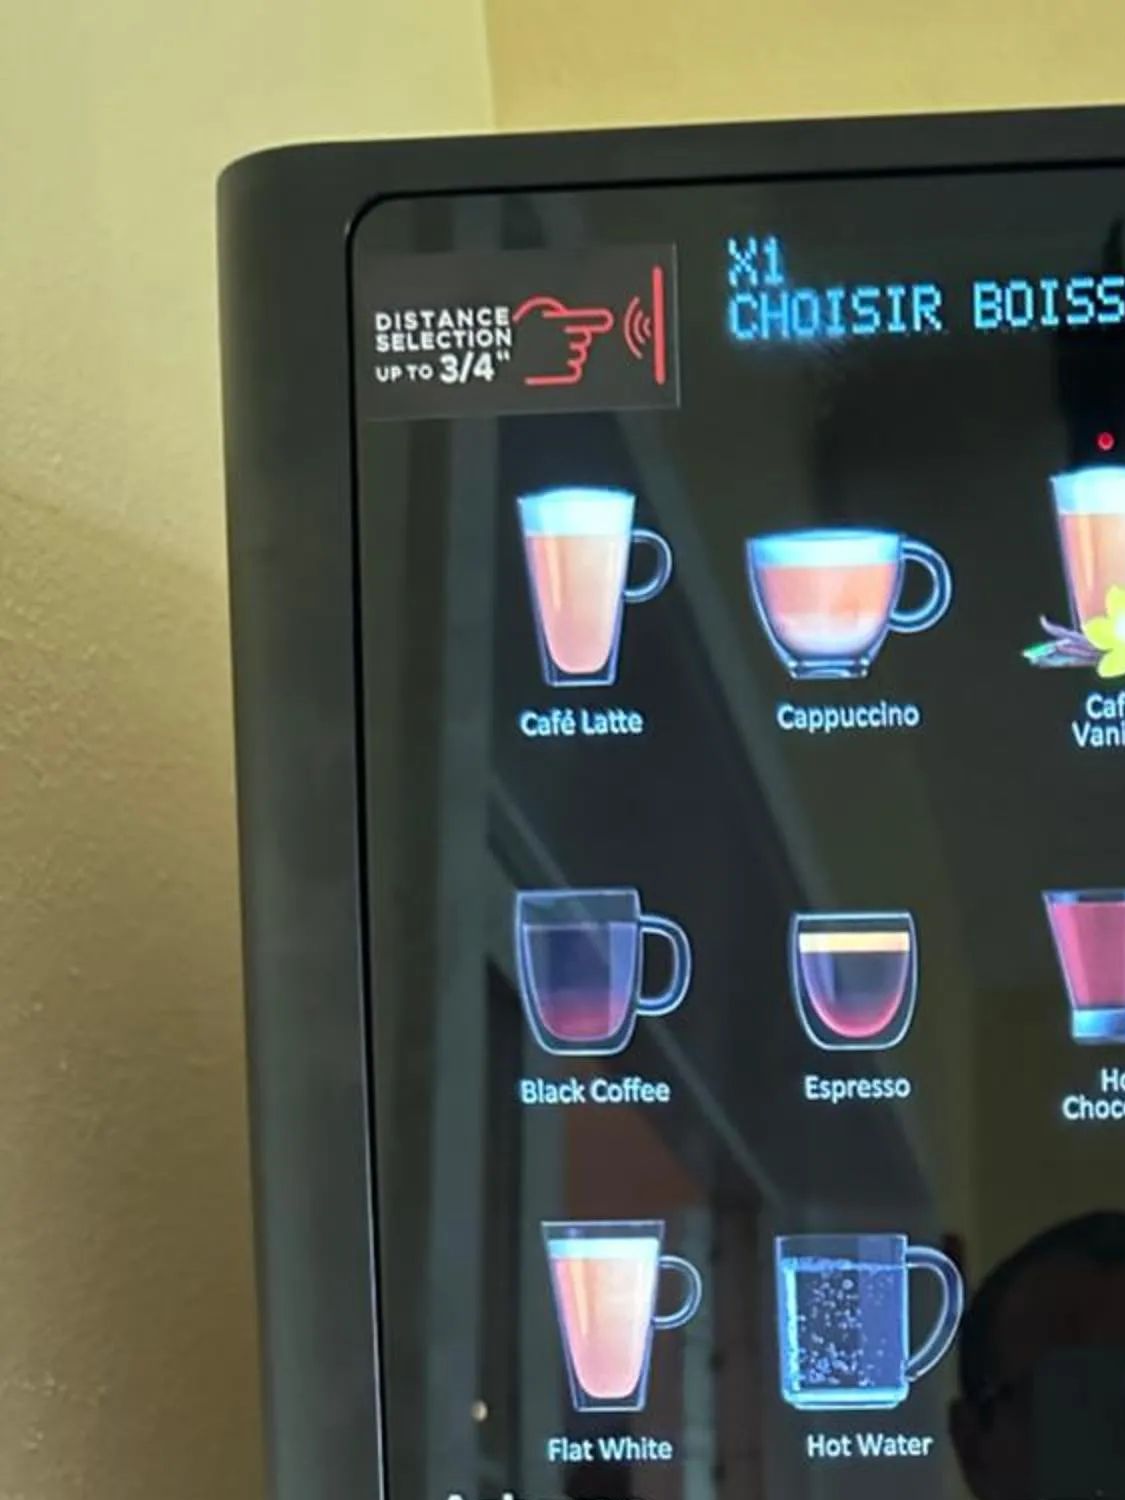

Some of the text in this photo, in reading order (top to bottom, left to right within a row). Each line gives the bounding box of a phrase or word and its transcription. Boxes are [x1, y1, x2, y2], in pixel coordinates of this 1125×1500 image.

[728, 235, 785, 286] X1
[374, 306, 510, 332] DISTANCE
[728, 282, 943, 340] CHOISIR
[375, 327, 513, 353] SELECTION
[375, 364, 403, 383] UP
[405, 362, 434, 382] TO
[519, 707, 644, 737] Café Latte
[776, 700, 921, 735] Cappuccino
[519, 1076, 671, 1104] Black Coffee
[803, 1074, 911, 1104] Espresso
[547, 1436, 673, 1462] Flat White
[806, 1433, 934, 1459] Hot Water
